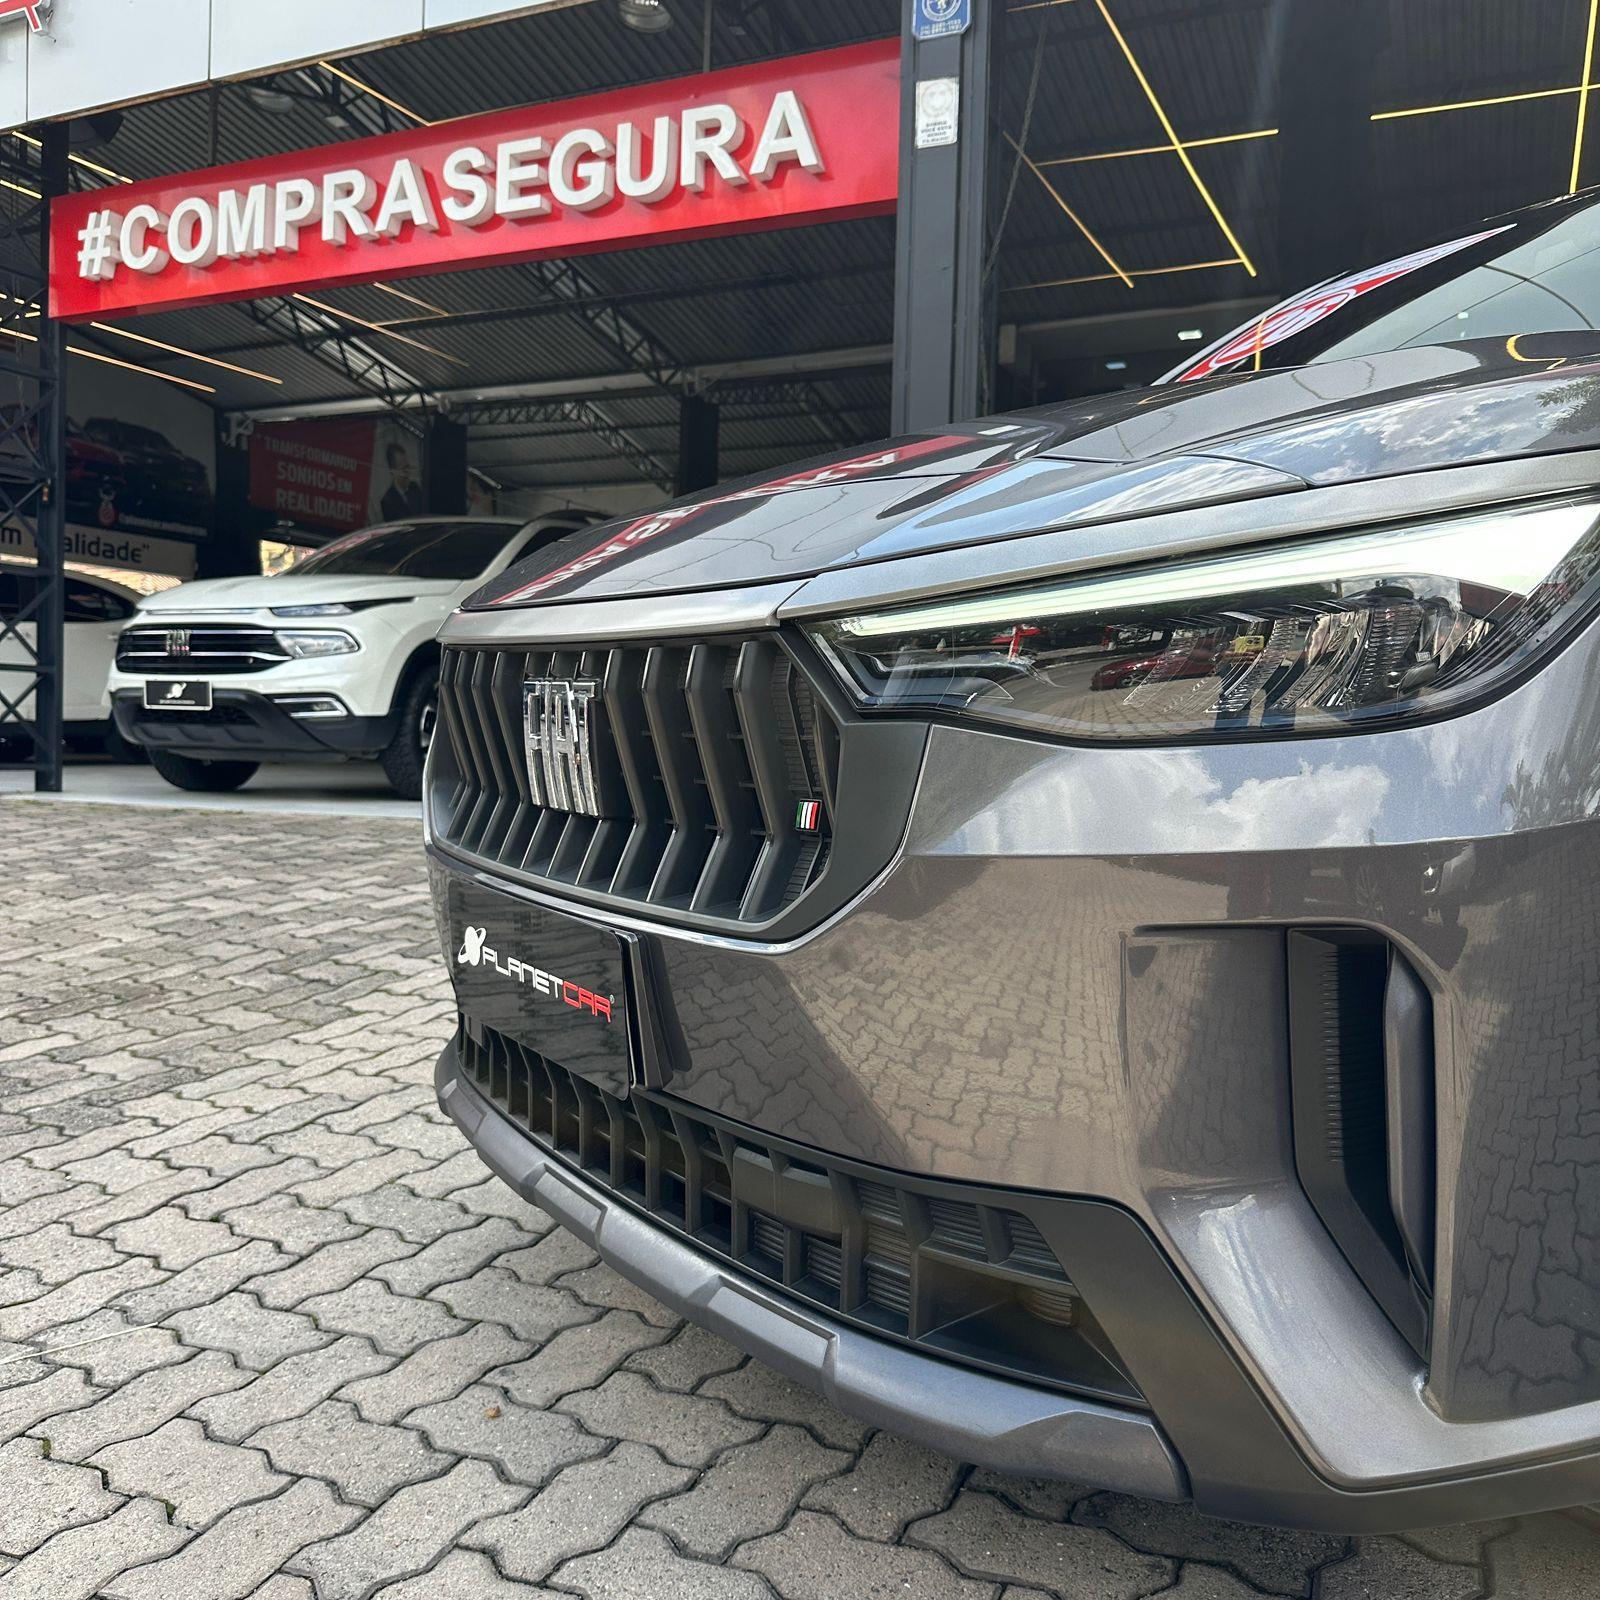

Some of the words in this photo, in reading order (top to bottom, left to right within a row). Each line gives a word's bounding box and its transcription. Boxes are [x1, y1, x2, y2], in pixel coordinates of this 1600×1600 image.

[276, 461, 336, 491] SONHOS
[337, 477, 353, 494] EM
[0, 526, 21, 546] m
[62, 534, 150, 563] alidade"
